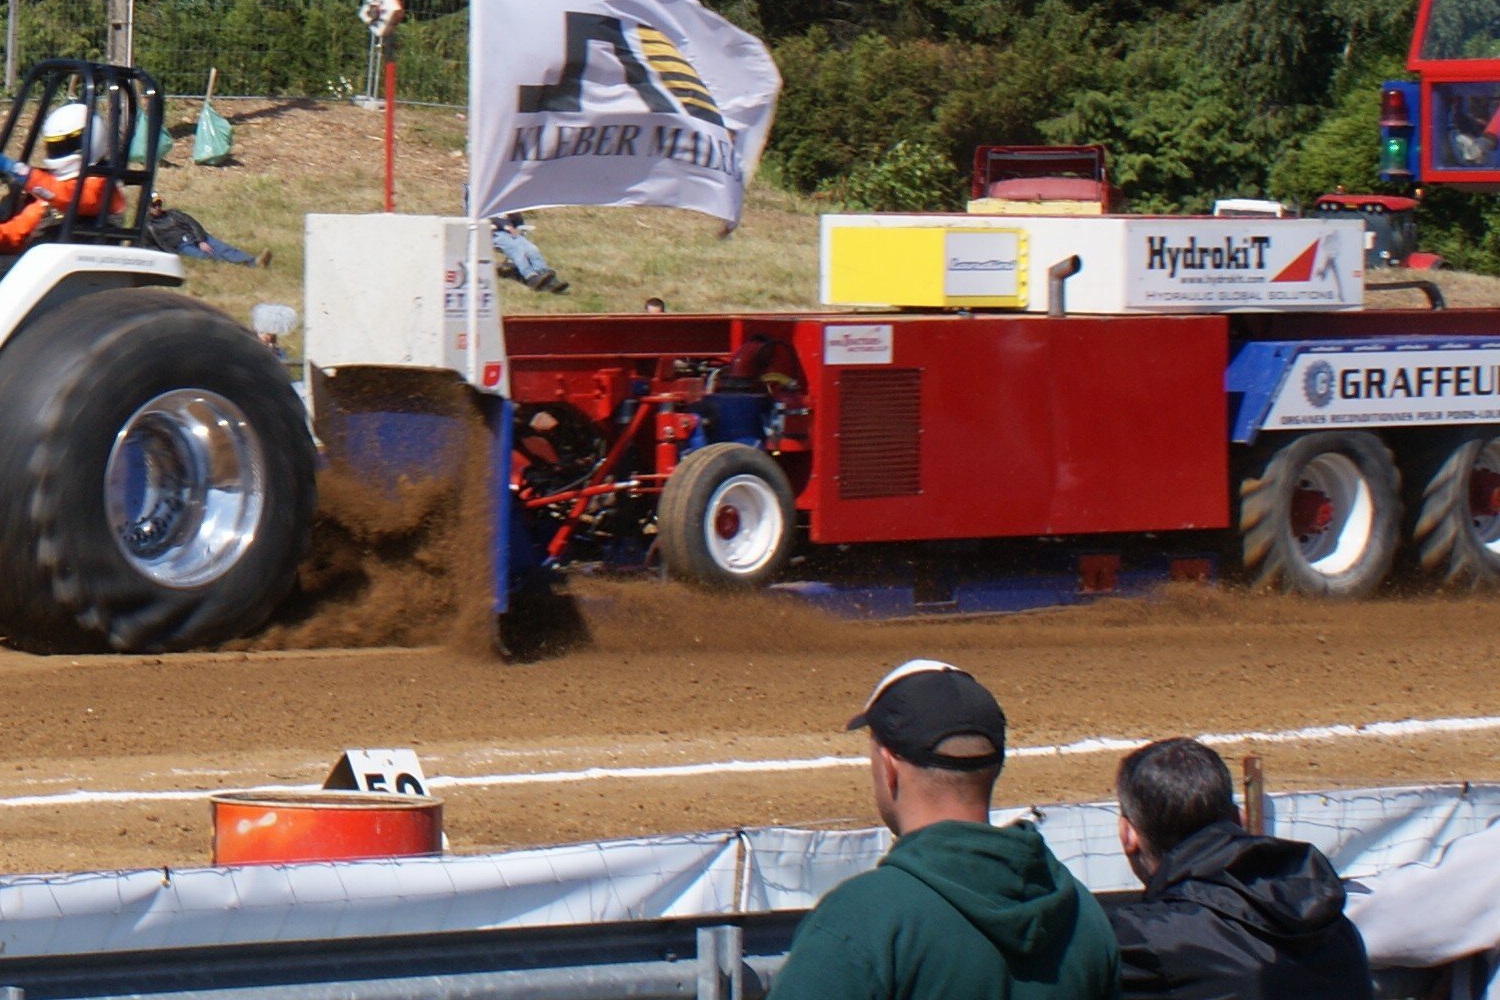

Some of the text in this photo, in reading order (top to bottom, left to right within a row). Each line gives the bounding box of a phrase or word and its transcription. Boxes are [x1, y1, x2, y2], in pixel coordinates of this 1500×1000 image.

[510, 124, 642, 161] KLEBER
[1146, 236, 1271, 278] HydrokiT
[1145, 290, 1334, 301] HYDRAULIC GLOBAL SOLUTIONS
[1340, 365, 1500, 400] GRAFFEU
[1280, 414, 1326, 425] ORGANES
[1417, 409, 1443, 421] POUR
